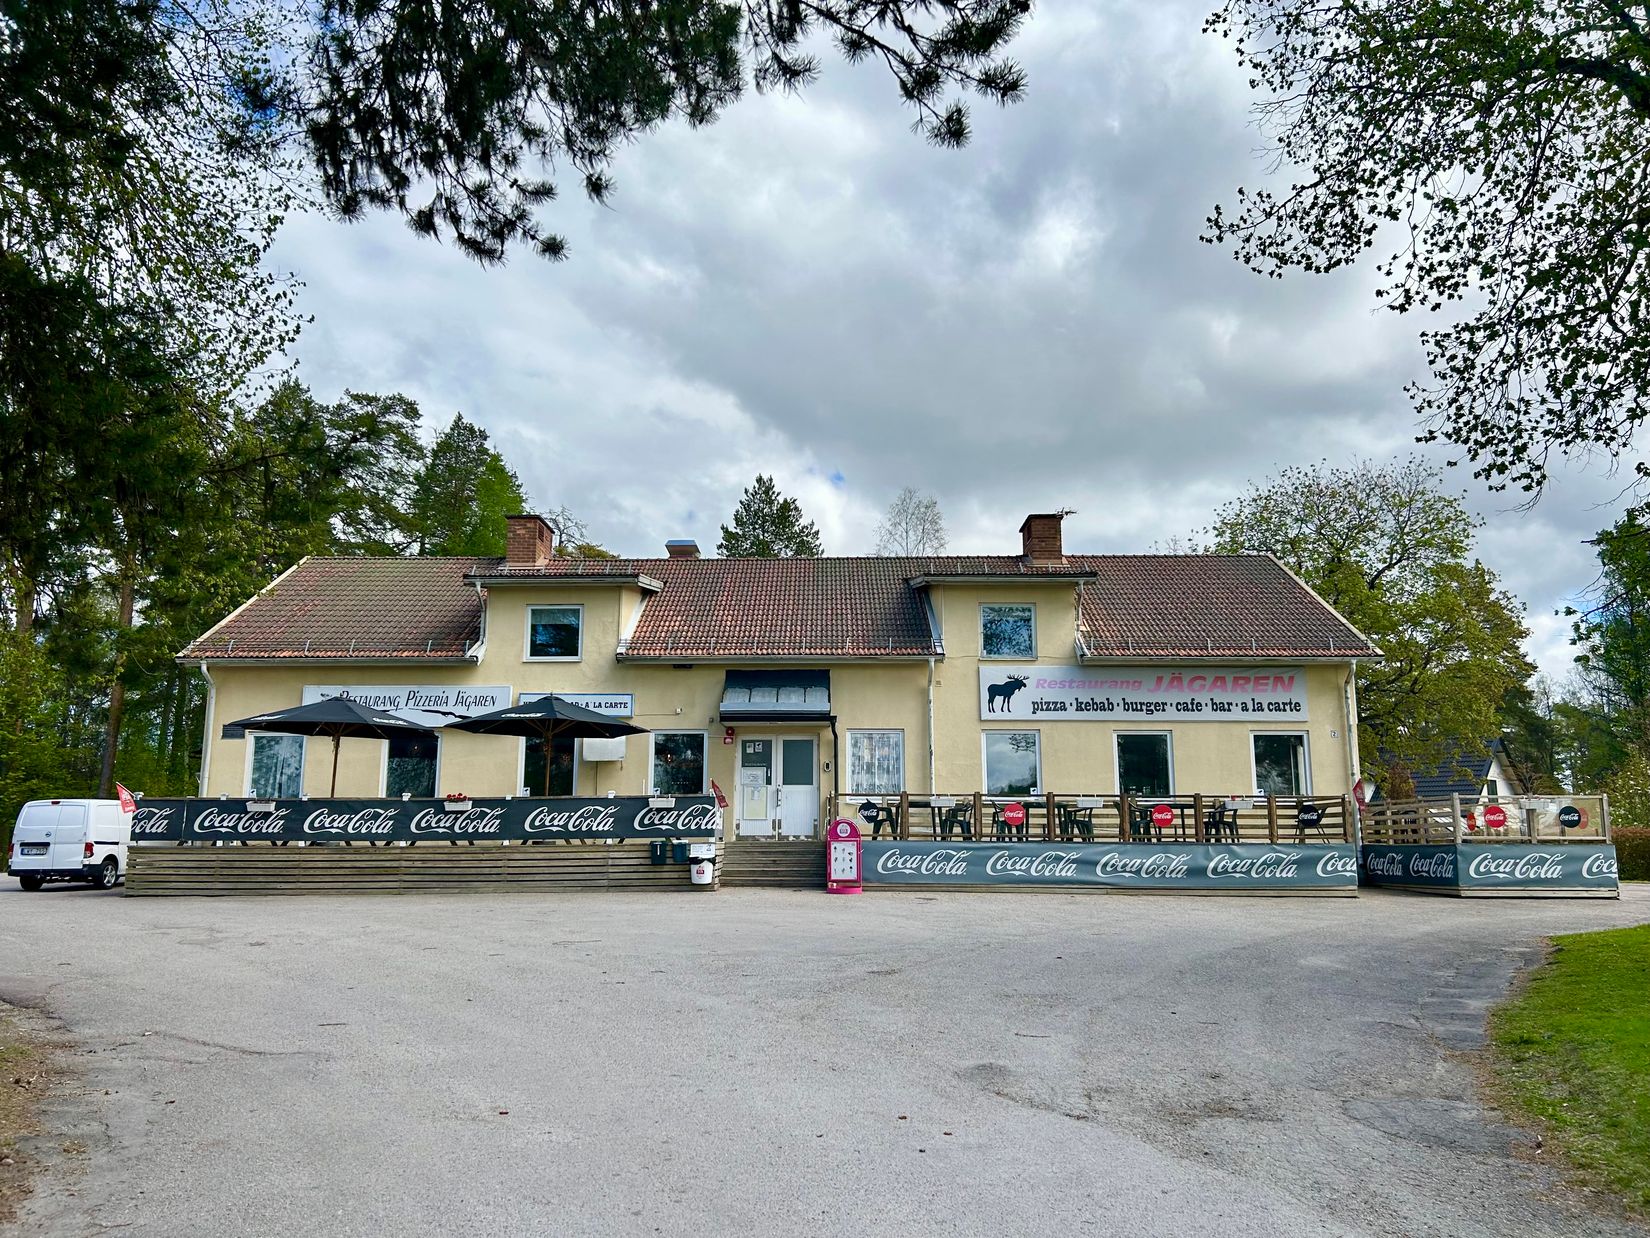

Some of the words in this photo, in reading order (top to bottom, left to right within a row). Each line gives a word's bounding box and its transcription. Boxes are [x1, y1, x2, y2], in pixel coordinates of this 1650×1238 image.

[1035, 677, 1143, 691] Restaurang
[1147, 672, 1295, 693] JÄGAREN
[1032, 697, 1067, 714] pizza
[1075, 697, 1115, 712] kebab
[1122, 697, 1168, 715] burger
[1175, 697, 1203, 712] cafe
[1210, 697, 1233, 712] bar
[1240, 701, 1249, 712] a
[1251, 697, 1264, 712] la
[1267, 697, 1302, 712] carte
[194, 807, 291, 833] Coca-Cola
[304, 808, 400, 834] Coca-Cola
[410, 806, 507, 834] Coca-Cola
[525, 805, 620, 832] Coca-Cola
[877, 849, 972, 875] Coca-Cola
[986, 850, 1082, 876] Coca-Cola
[1096, 852, 1192, 878] Coca-Cola
[1207, 852, 1303, 878] Coca-Cola
[1410, 853, 1455, 878] Coca-Cola
[1469, 853, 1567, 878] Coca-Cola
